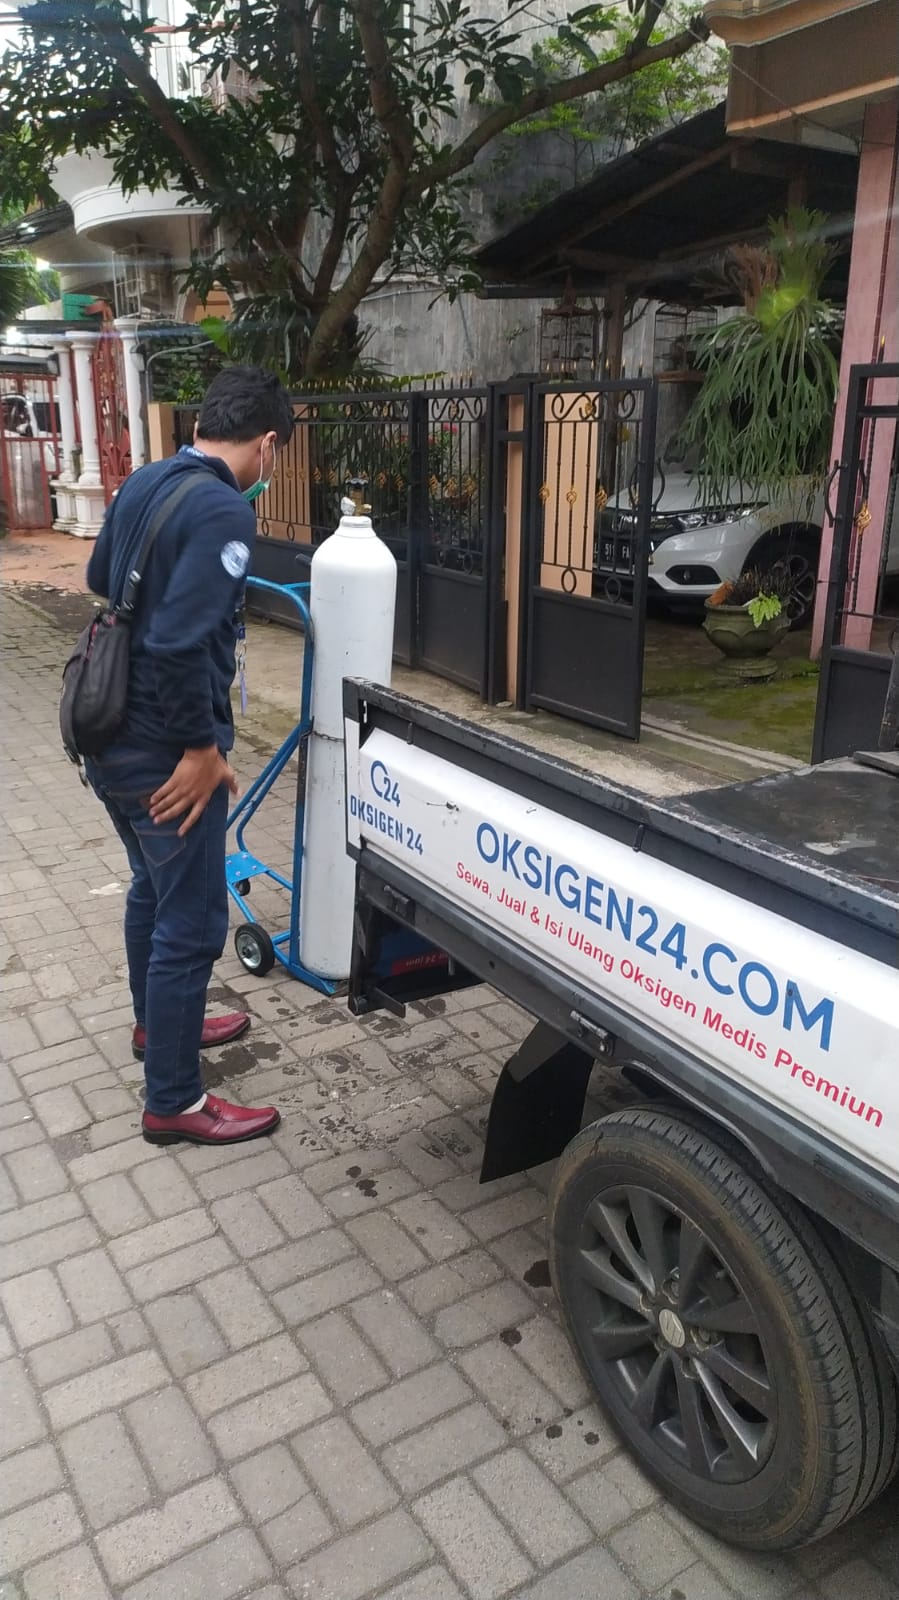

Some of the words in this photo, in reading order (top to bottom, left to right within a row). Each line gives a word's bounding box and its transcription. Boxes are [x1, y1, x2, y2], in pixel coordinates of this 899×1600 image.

[350, 794, 403, 844] OKSIGEN
[406, 827, 424, 855] 24
[476, 822, 835, 1052] OKSIGEN24.COM
[456, 862, 493, 899] Sewa,
[496, 888, 526, 917] Jual
[530, 906, 541, 925] &
[545, 914, 563, 938] Isi
[567, 927, 614, 973] Ulang
[620, 959, 697, 1018] Oksigen
[703, 1007, 767, 1060] Medis
[773, 1048, 884, 1128] Premiun
